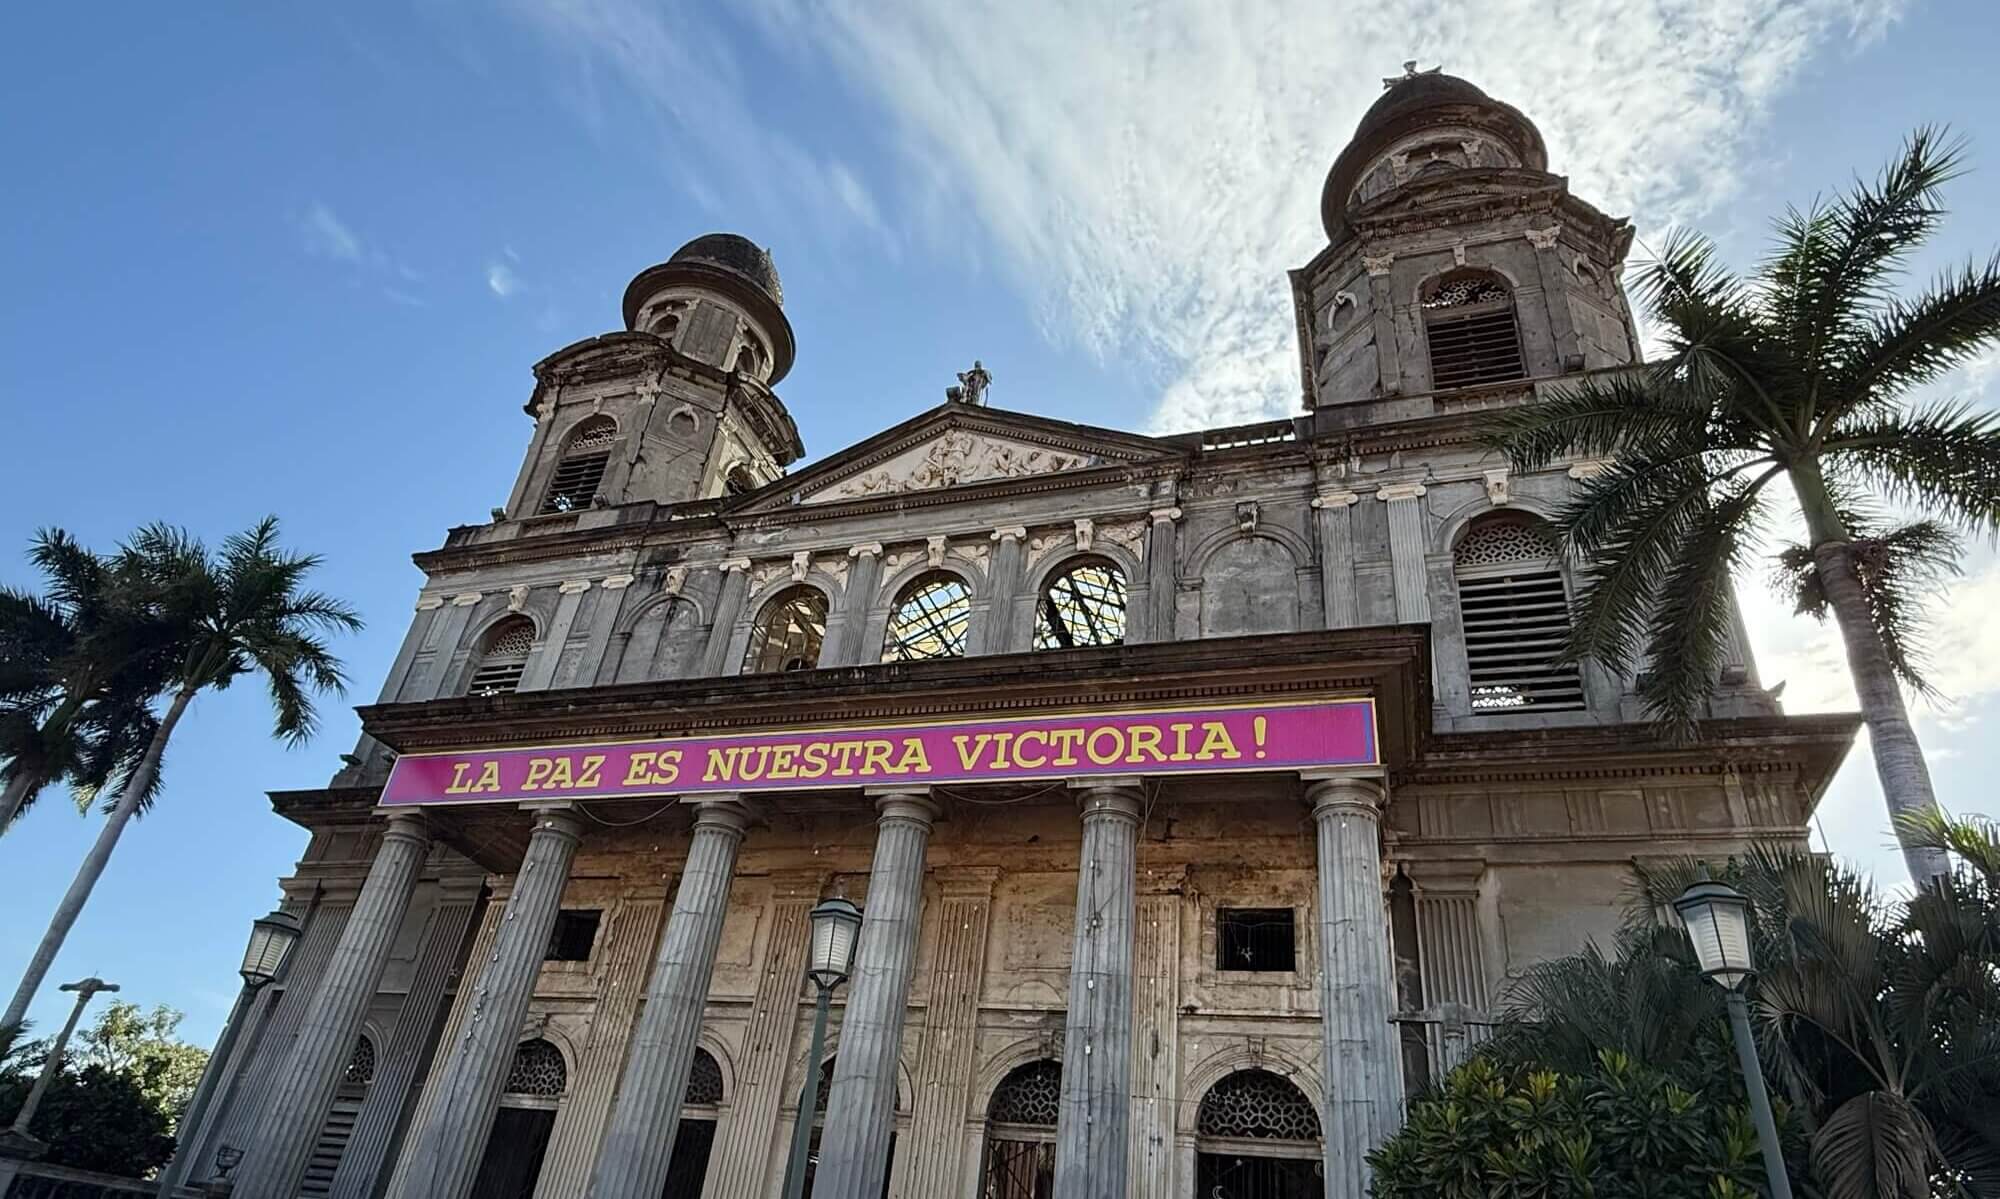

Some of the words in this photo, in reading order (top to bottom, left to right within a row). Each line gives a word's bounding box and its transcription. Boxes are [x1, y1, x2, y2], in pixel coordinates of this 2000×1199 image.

[445, 761, 500, 794] LA
[521, 755, 606, 791] PAZ
[622, 751, 683, 786] ES
[701, 738, 932, 782] NUESTRA
